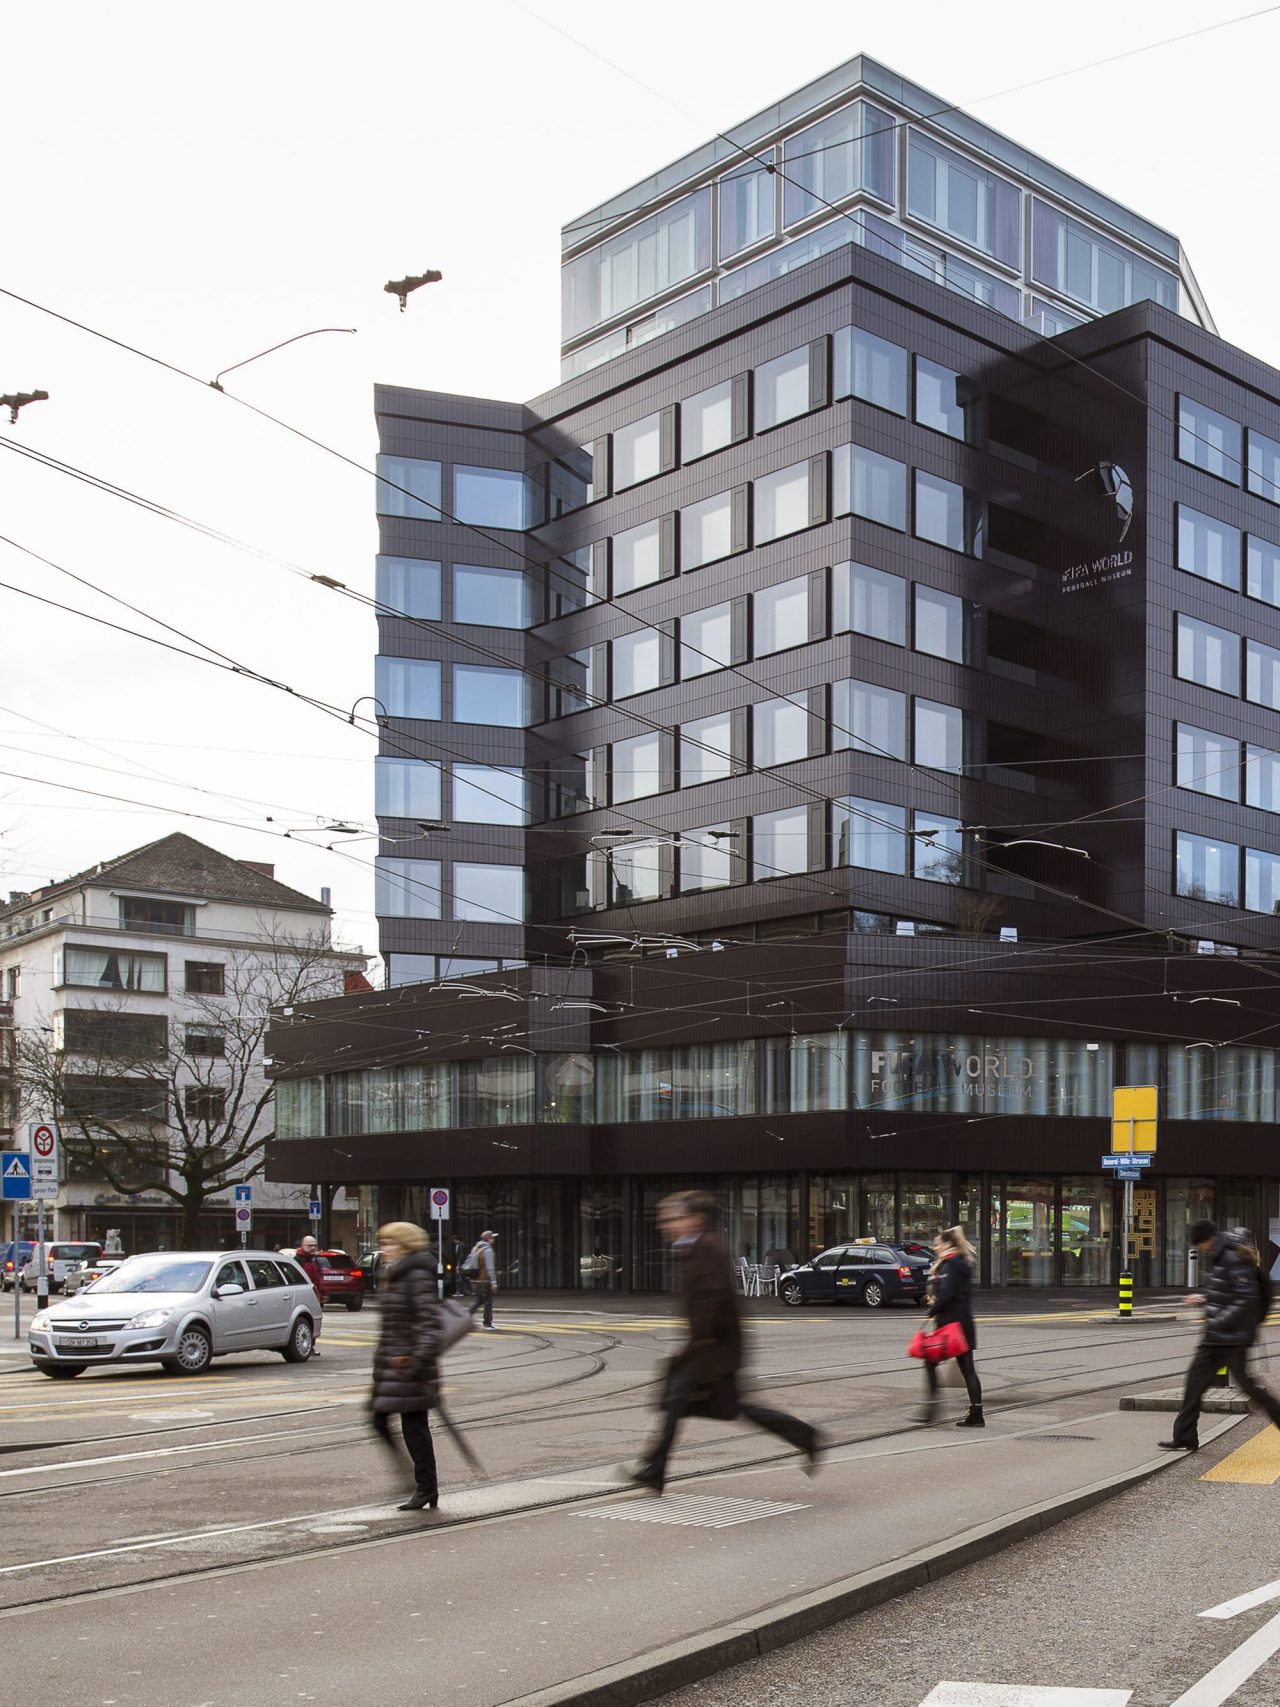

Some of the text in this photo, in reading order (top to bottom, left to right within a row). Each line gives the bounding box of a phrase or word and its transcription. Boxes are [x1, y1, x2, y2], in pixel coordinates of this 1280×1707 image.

[1062, 551, 1133, 581] FIFA WORLD
[1062, 569, 1132, 593] FOOTBALL MUSEUM
[871, 1050, 1033, 1079] FIFA WORLD
